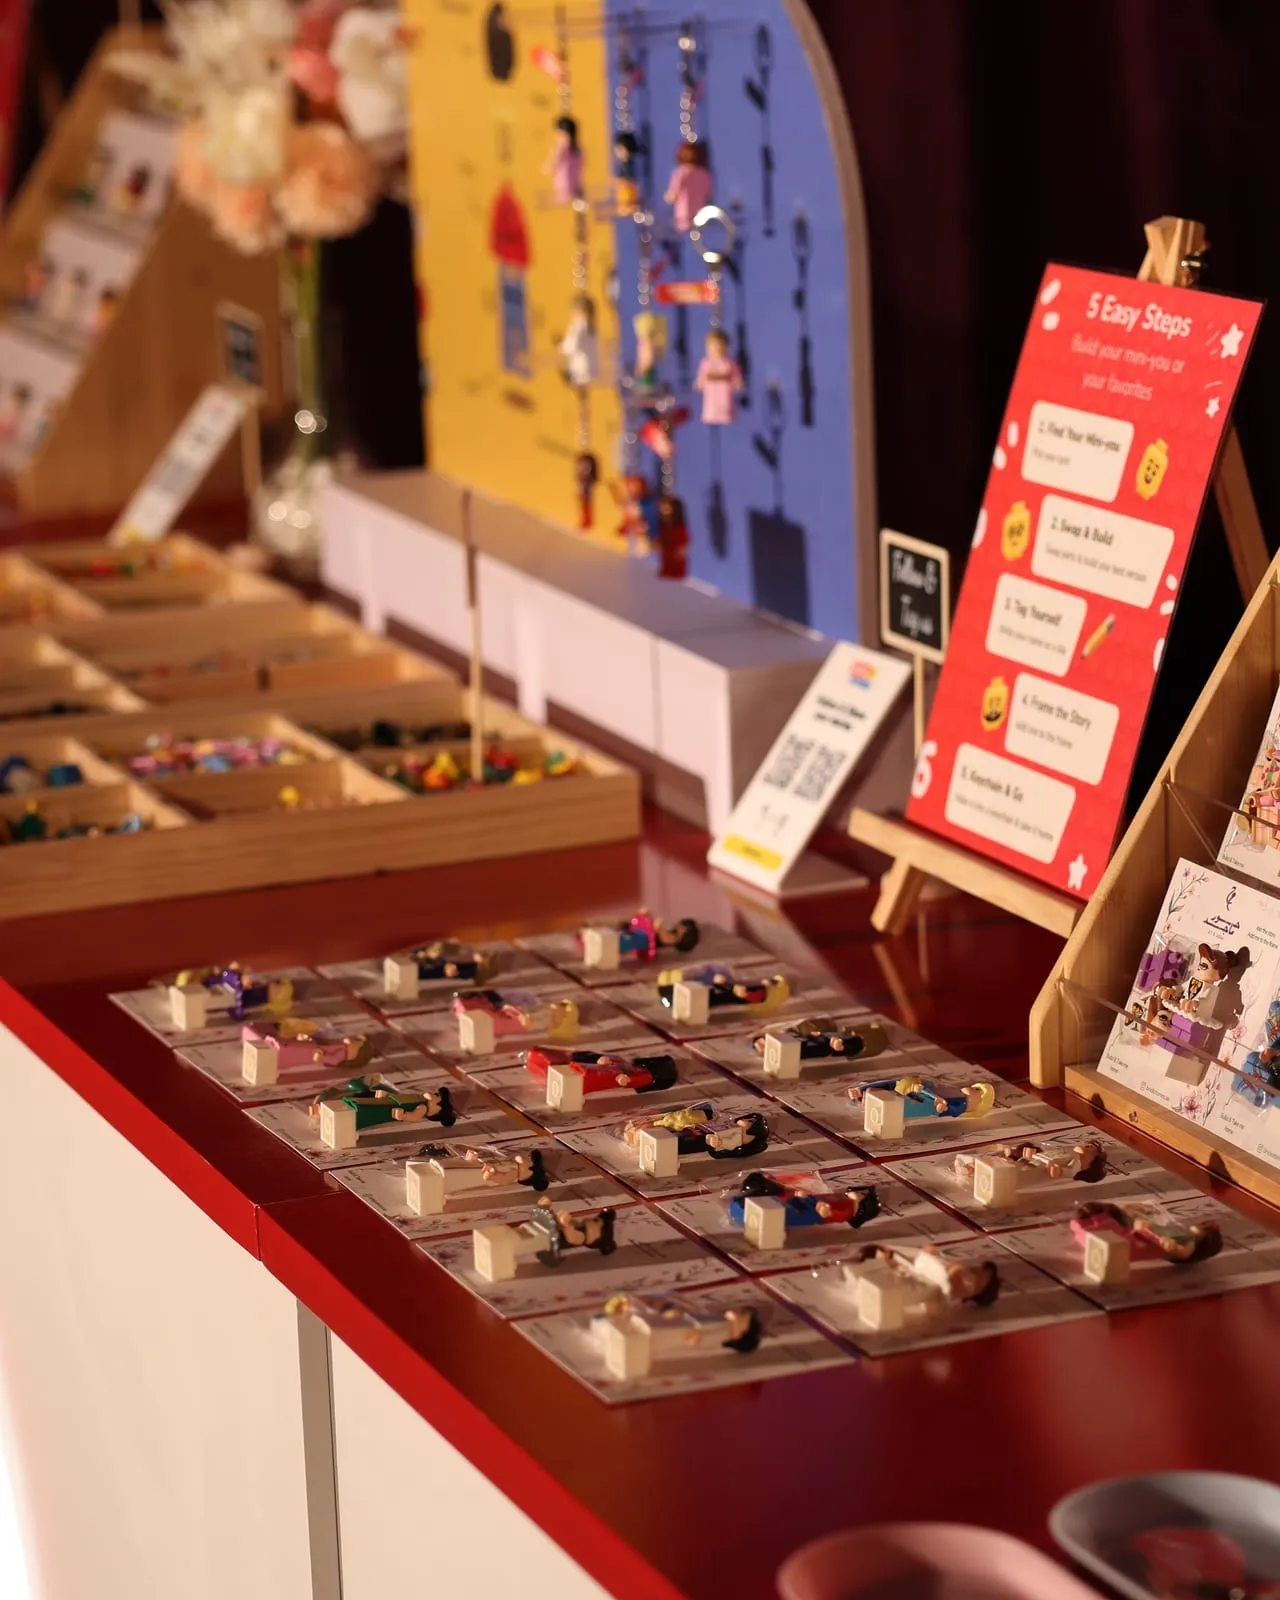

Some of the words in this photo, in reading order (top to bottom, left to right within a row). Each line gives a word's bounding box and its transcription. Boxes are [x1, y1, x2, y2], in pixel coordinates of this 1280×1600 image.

[1086, 292, 1102, 319] 5
[1100, 294, 1141, 332] Easy
[1141, 302, 1193, 340] Steps
[1070, 333, 1100, 356] Build
[1098, 345, 1123, 361] your
[1171, 360, 1185, 373] or
[1082, 373, 1107, 390] your
[1106, 374, 1153, 400] favorites
[1060, 518, 1082, 537] Swap
[1092, 527, 1114, 546] Build
[1030, 695, 1054, 716] Frame
[1056, 706, 1069, 720] the
[1069, 708, 1091, 733] Story
